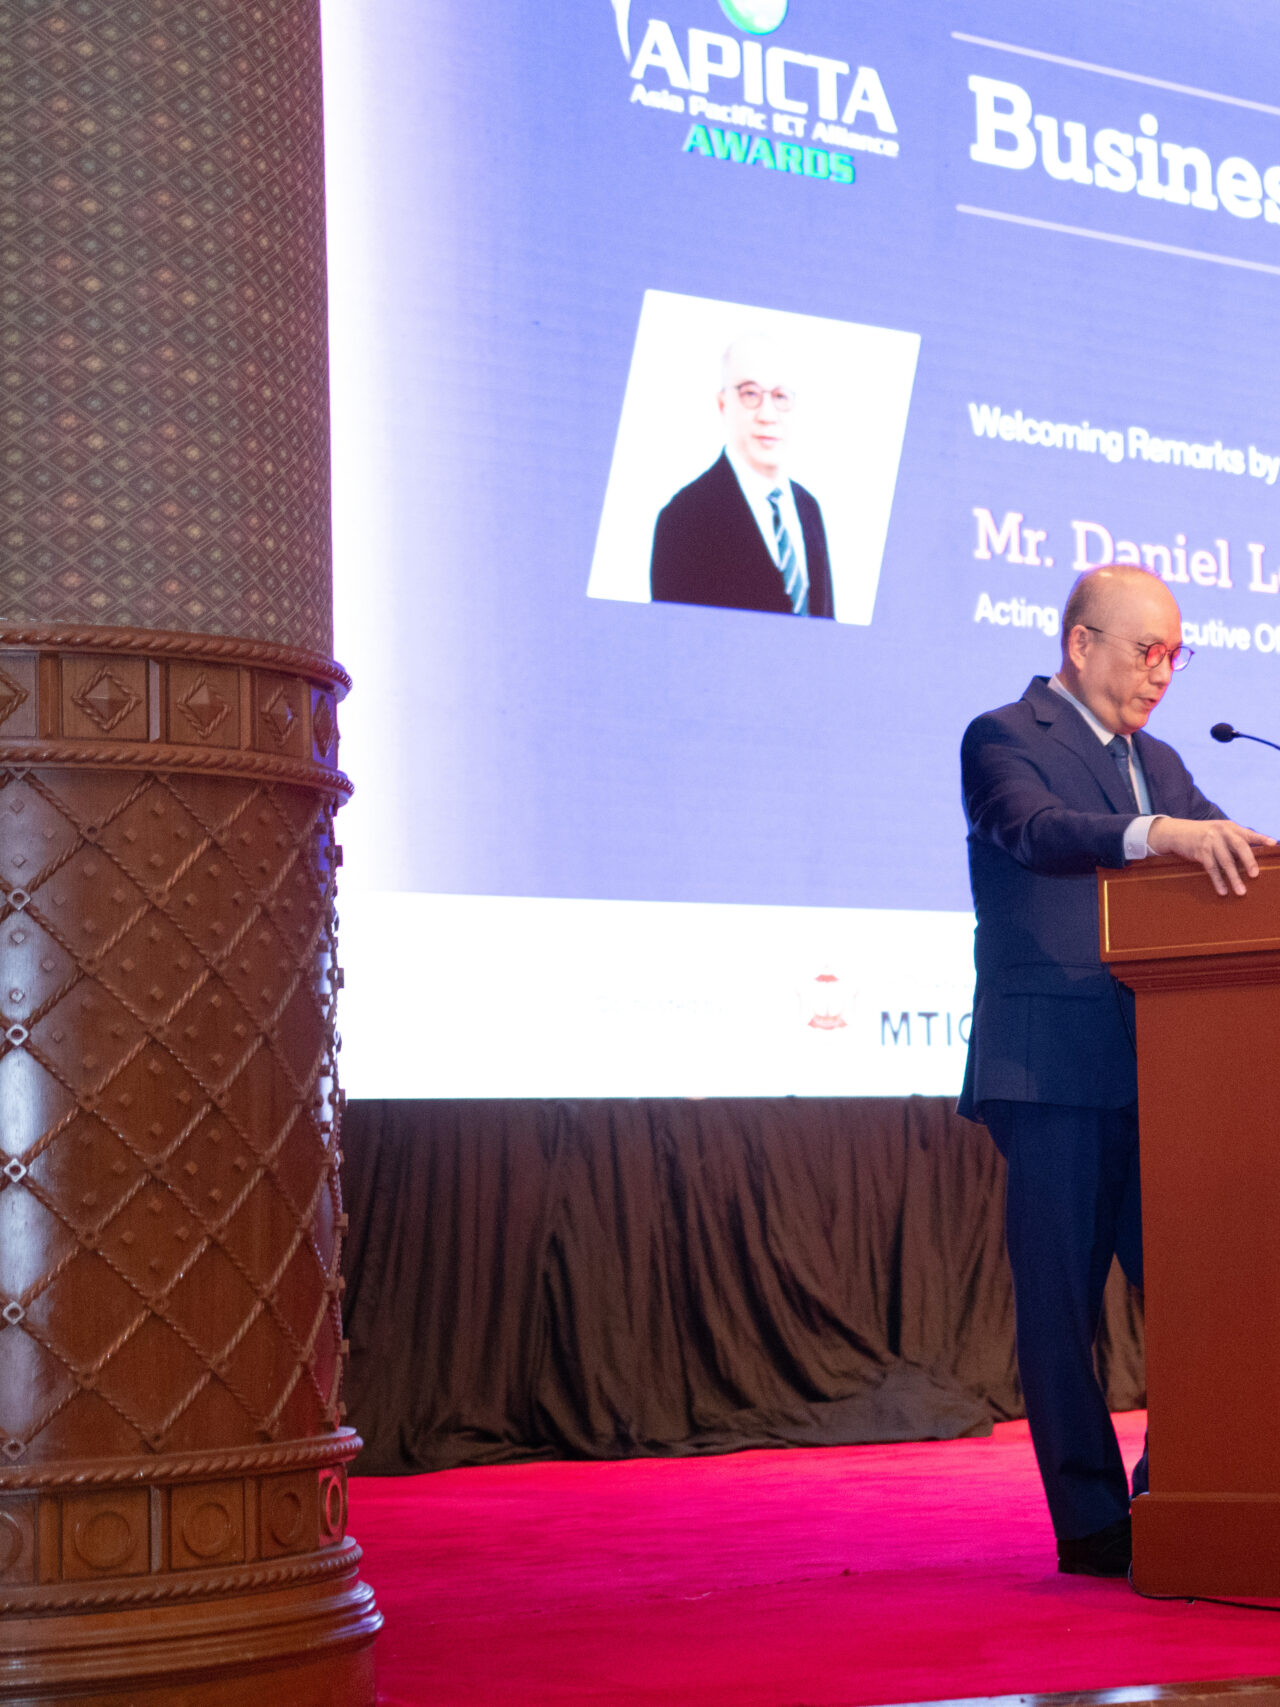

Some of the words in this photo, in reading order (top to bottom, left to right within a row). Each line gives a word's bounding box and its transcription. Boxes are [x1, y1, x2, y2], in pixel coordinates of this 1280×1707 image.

[630, 19, 898, 134] APICTA
[629, 84, 685, 113] Asia
[688, 95, 767, 130] Pacific
[811, 121, 900, 158] Alliance
[682, 124, 856, 185] AWARDS
[968, 402, 1124, 463] Welcoming
[1127, 427, 1246, 476] Remarks
[1248, 445, 1280, 485] by
[972, 507, 1054, 567] Mr.
[1070, 520, 1233, 588] Daniel
[974, 592, 1060, 637] Acting
[1181, 619, 1251, 651] cutive
